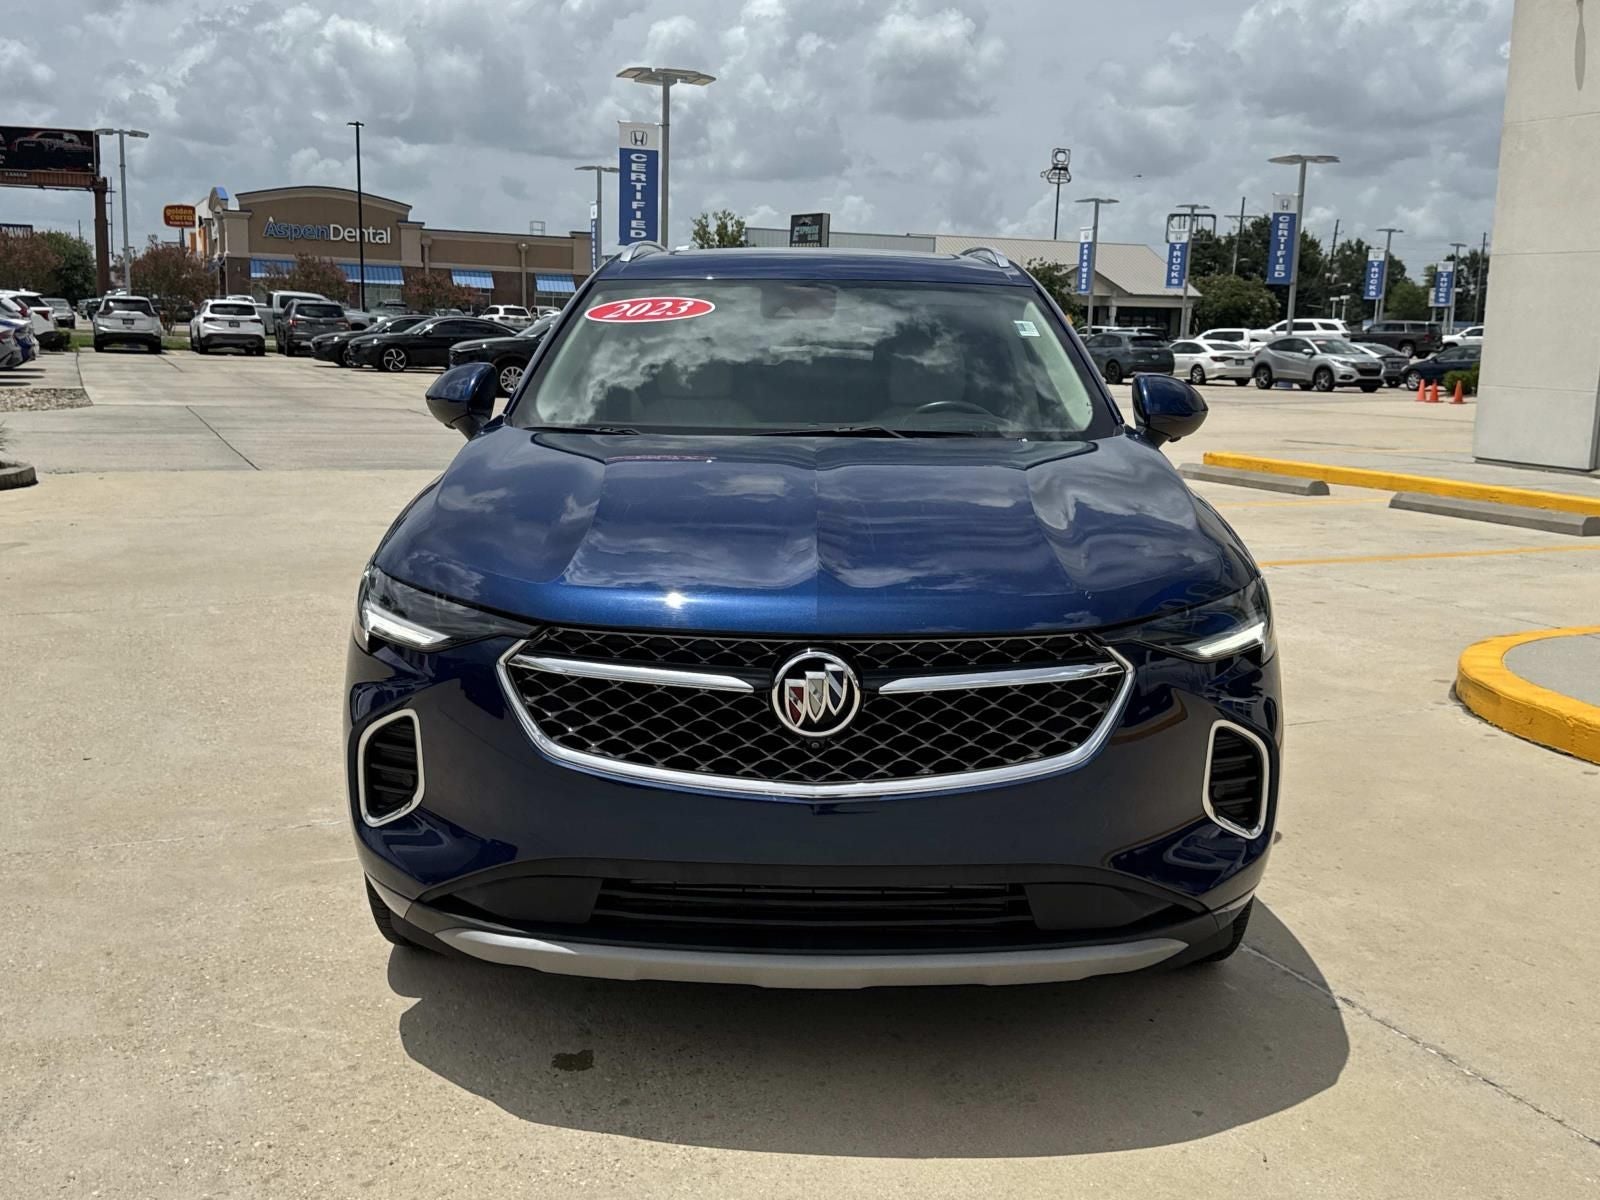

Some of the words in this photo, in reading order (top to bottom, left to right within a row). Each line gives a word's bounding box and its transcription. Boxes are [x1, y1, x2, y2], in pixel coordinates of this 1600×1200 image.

[629, 153, 648, 239] CERTIFIED
[1170, 243, 1182, 285] TRUCKS
[1273, 215, 1290, 278] CERTIFIED
[1368, 261, 1380, 297] TRUCKS
[1438, 272, 1449, 303] TRUCKS
[602, 301, 695, 319] 2023
